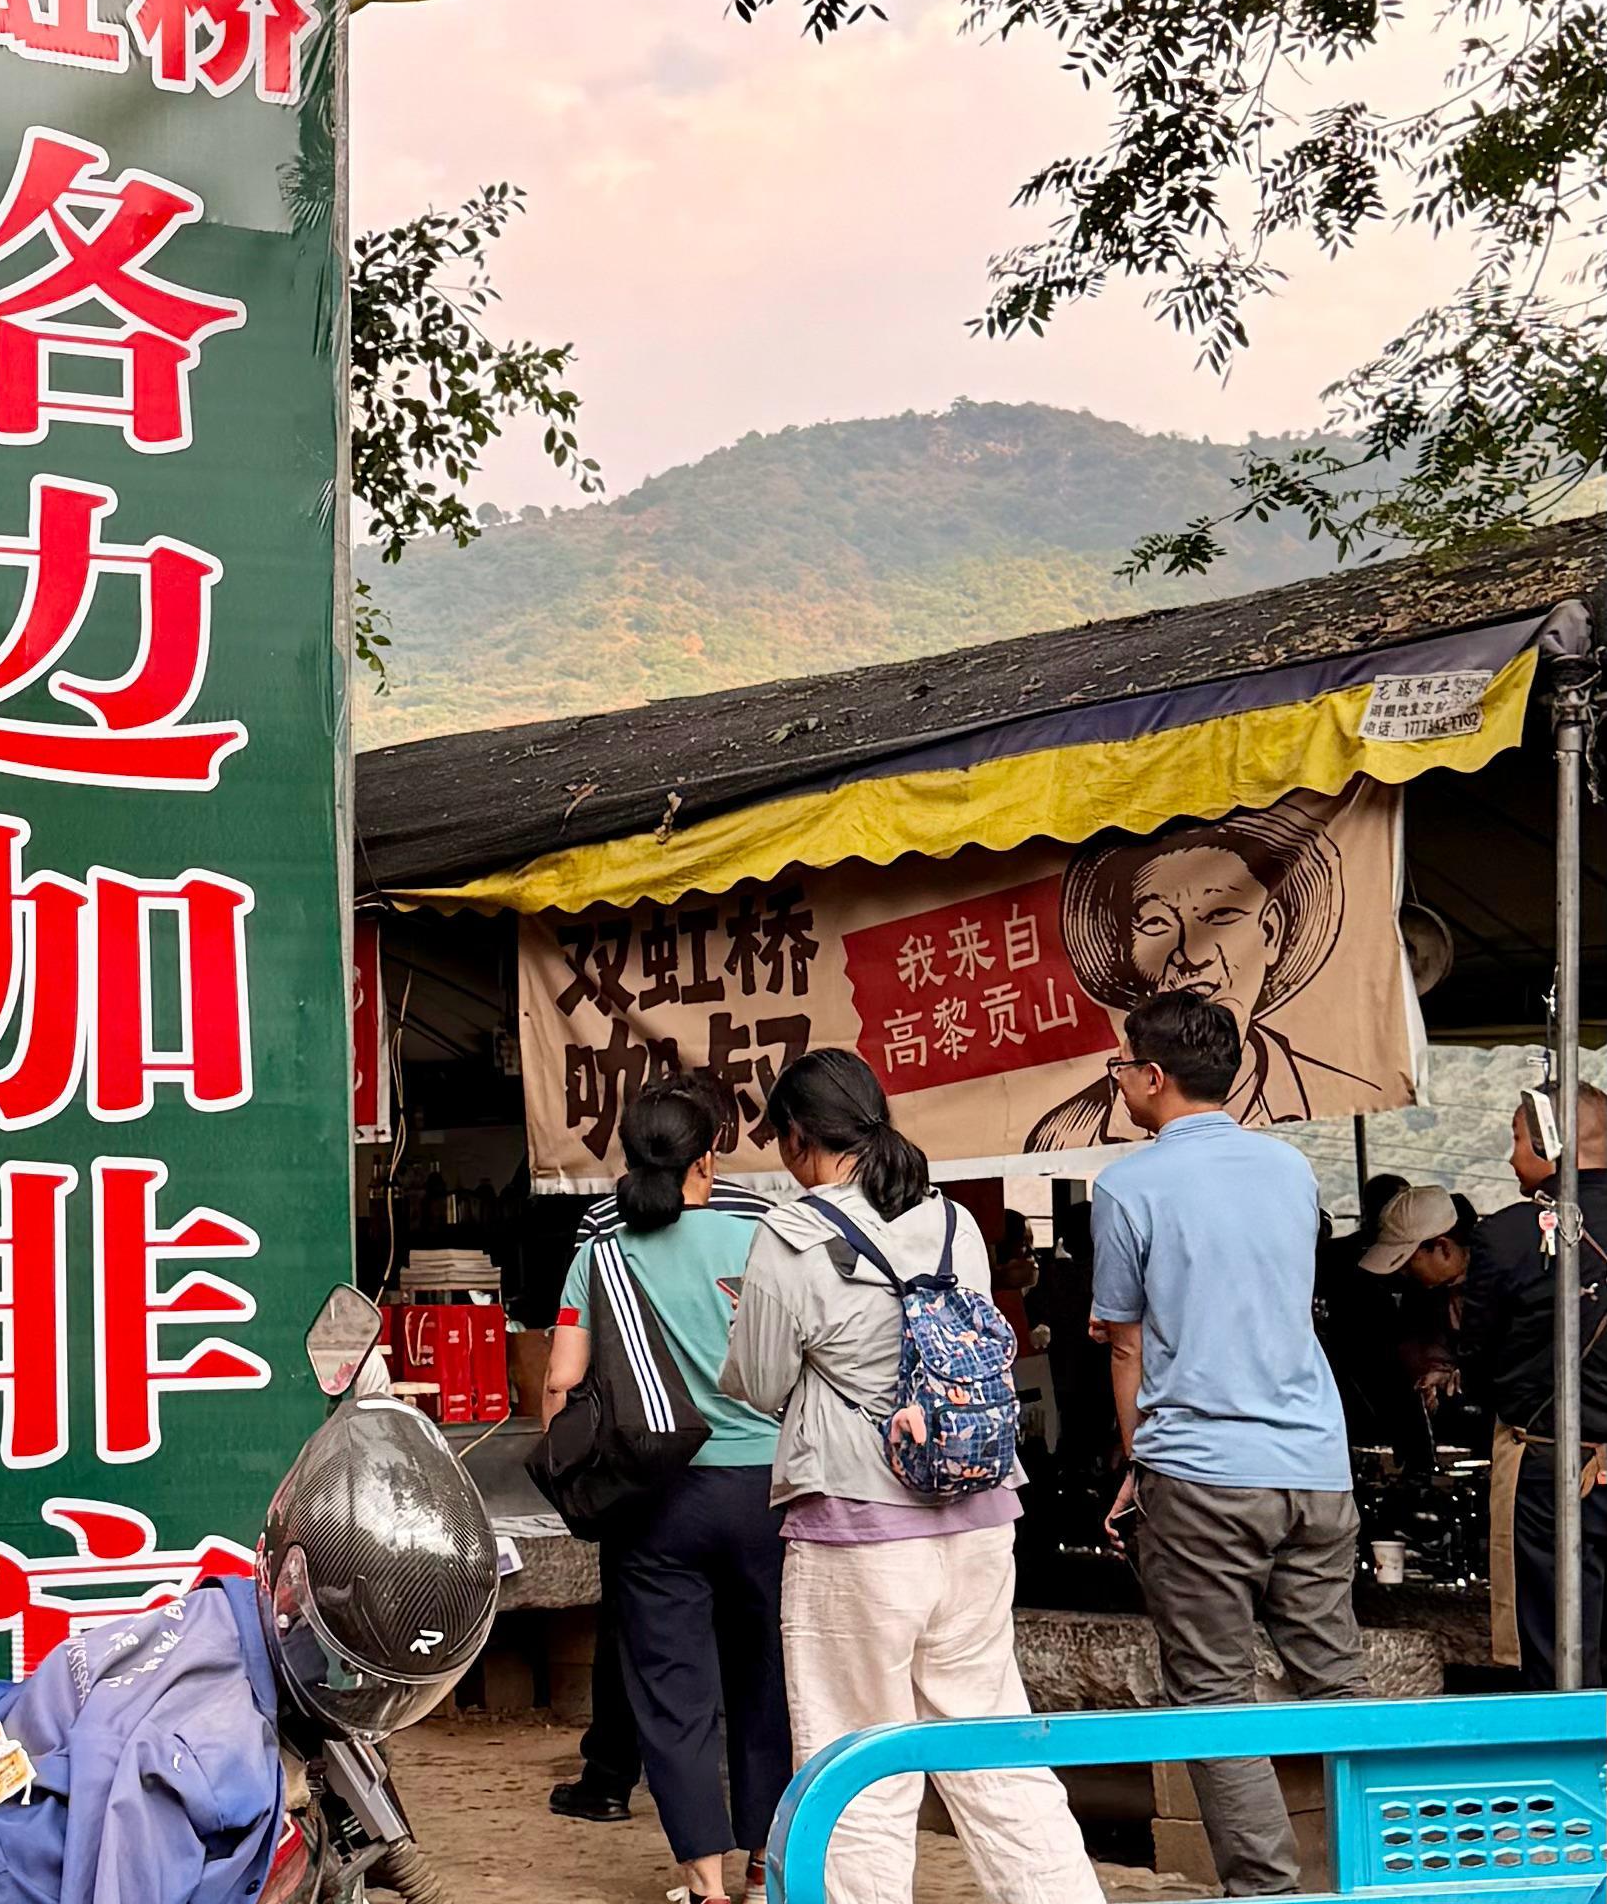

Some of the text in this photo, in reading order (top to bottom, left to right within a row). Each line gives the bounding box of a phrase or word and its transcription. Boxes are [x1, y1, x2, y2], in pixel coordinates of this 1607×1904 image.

[555, 896, 819, 1016] 双虹桥
[896, 903, 1042, 994] 我来自
[882, 977, 1079, 1073] 高黎贡山
